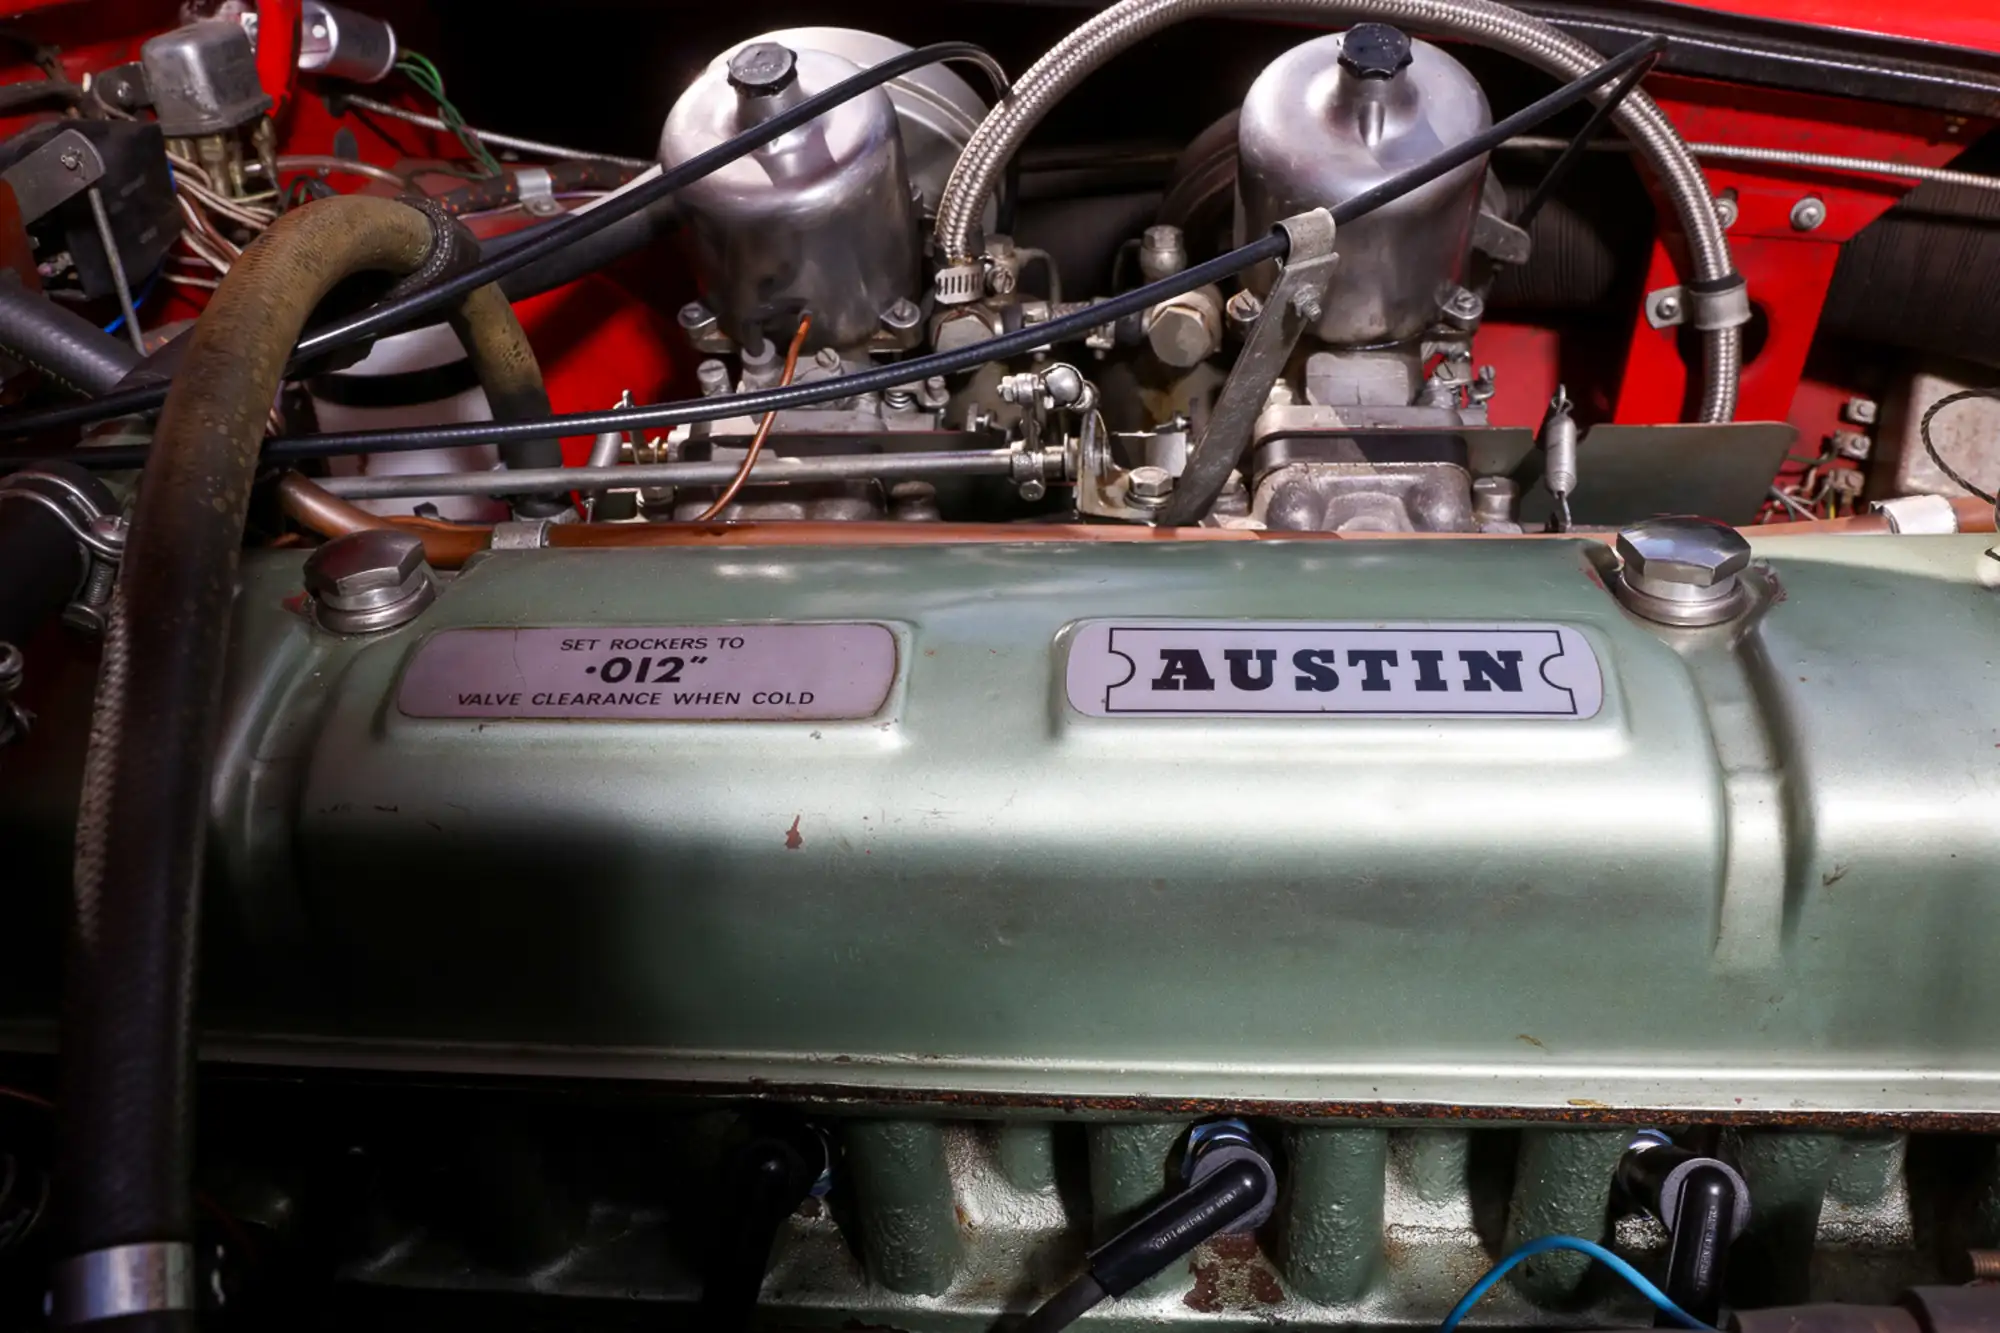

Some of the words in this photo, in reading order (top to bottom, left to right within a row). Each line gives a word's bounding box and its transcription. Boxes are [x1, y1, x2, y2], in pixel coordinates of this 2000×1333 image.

[560, 638, 602, 652] SET
[609, 637, 709, 651] ROCKERS
[716, 636, 745, 650] TO
[1150, 648, 1524, 693] AUSTIN
[457, 692, 521, 706] VALVE
[530, 692, 663, 706] CLEARANCE
[673, 691, 741, 706] WHEN
[752, 691, 815, 706] COLD
